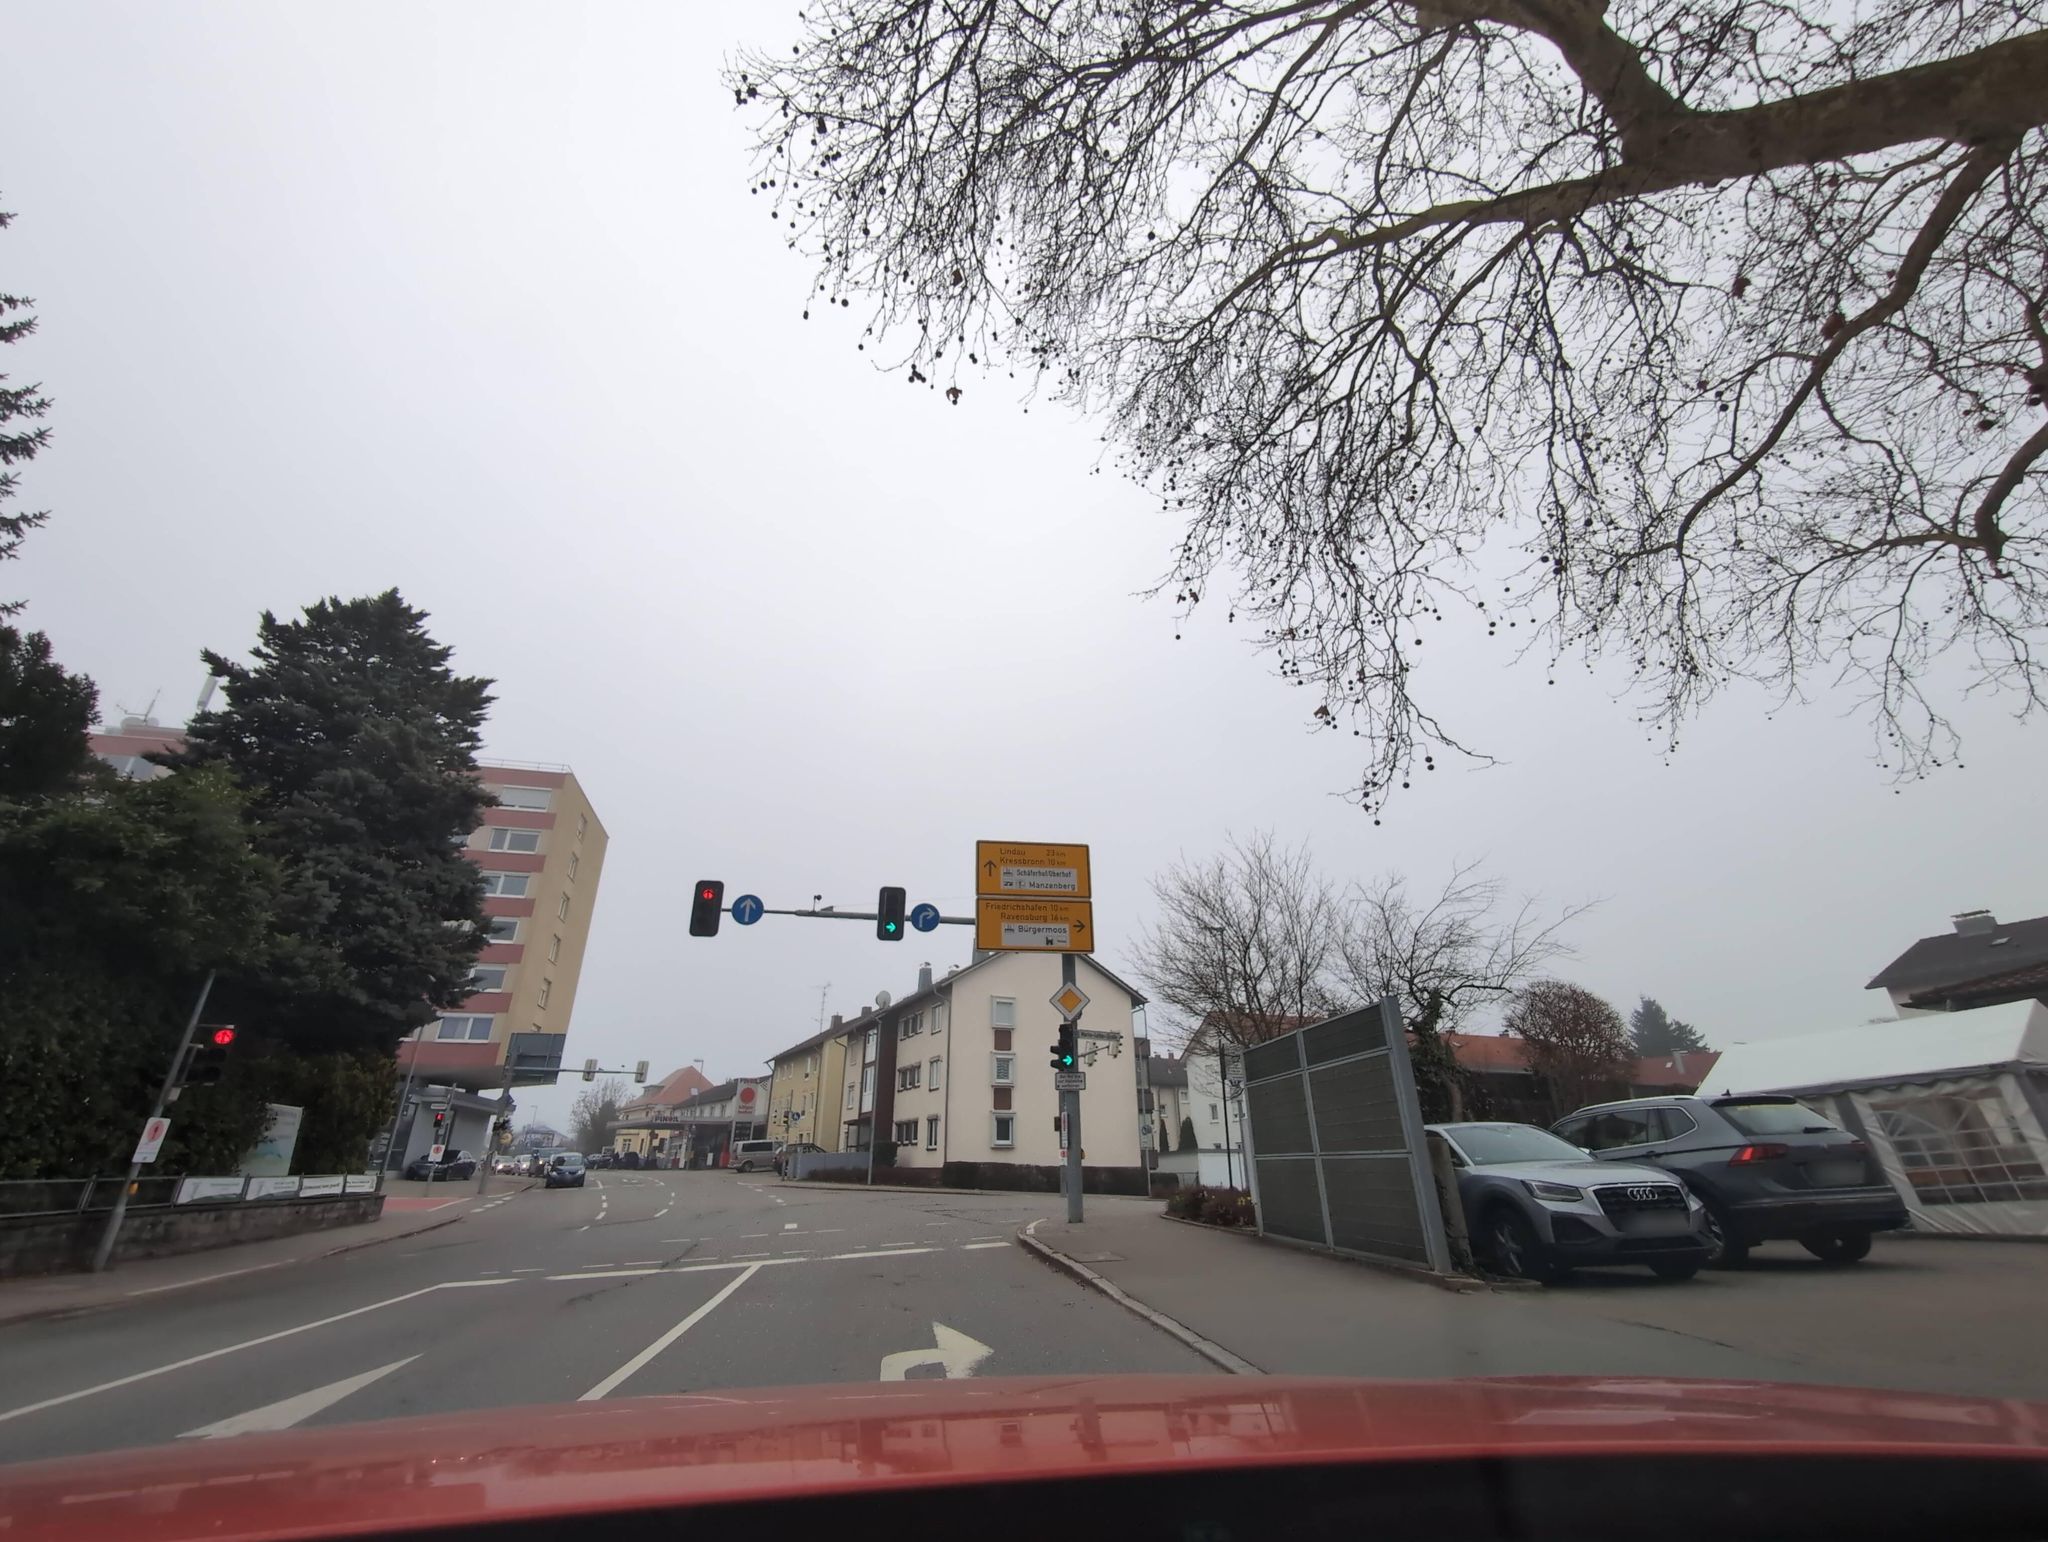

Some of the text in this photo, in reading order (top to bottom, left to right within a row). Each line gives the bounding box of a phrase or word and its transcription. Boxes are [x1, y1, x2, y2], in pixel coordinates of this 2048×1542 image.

[1000, 847, 1026, 856] Lindau
[1000, 856, 1045, 865] Kressbronn
[1029, 881, 1076, 891] Manzenberg
[985, 902, 1048, 912] Friedrichshafen
[1000, 912, 1048, 923] Ravensburg
[1018, 924, 1067, 935] Bürgermoos
